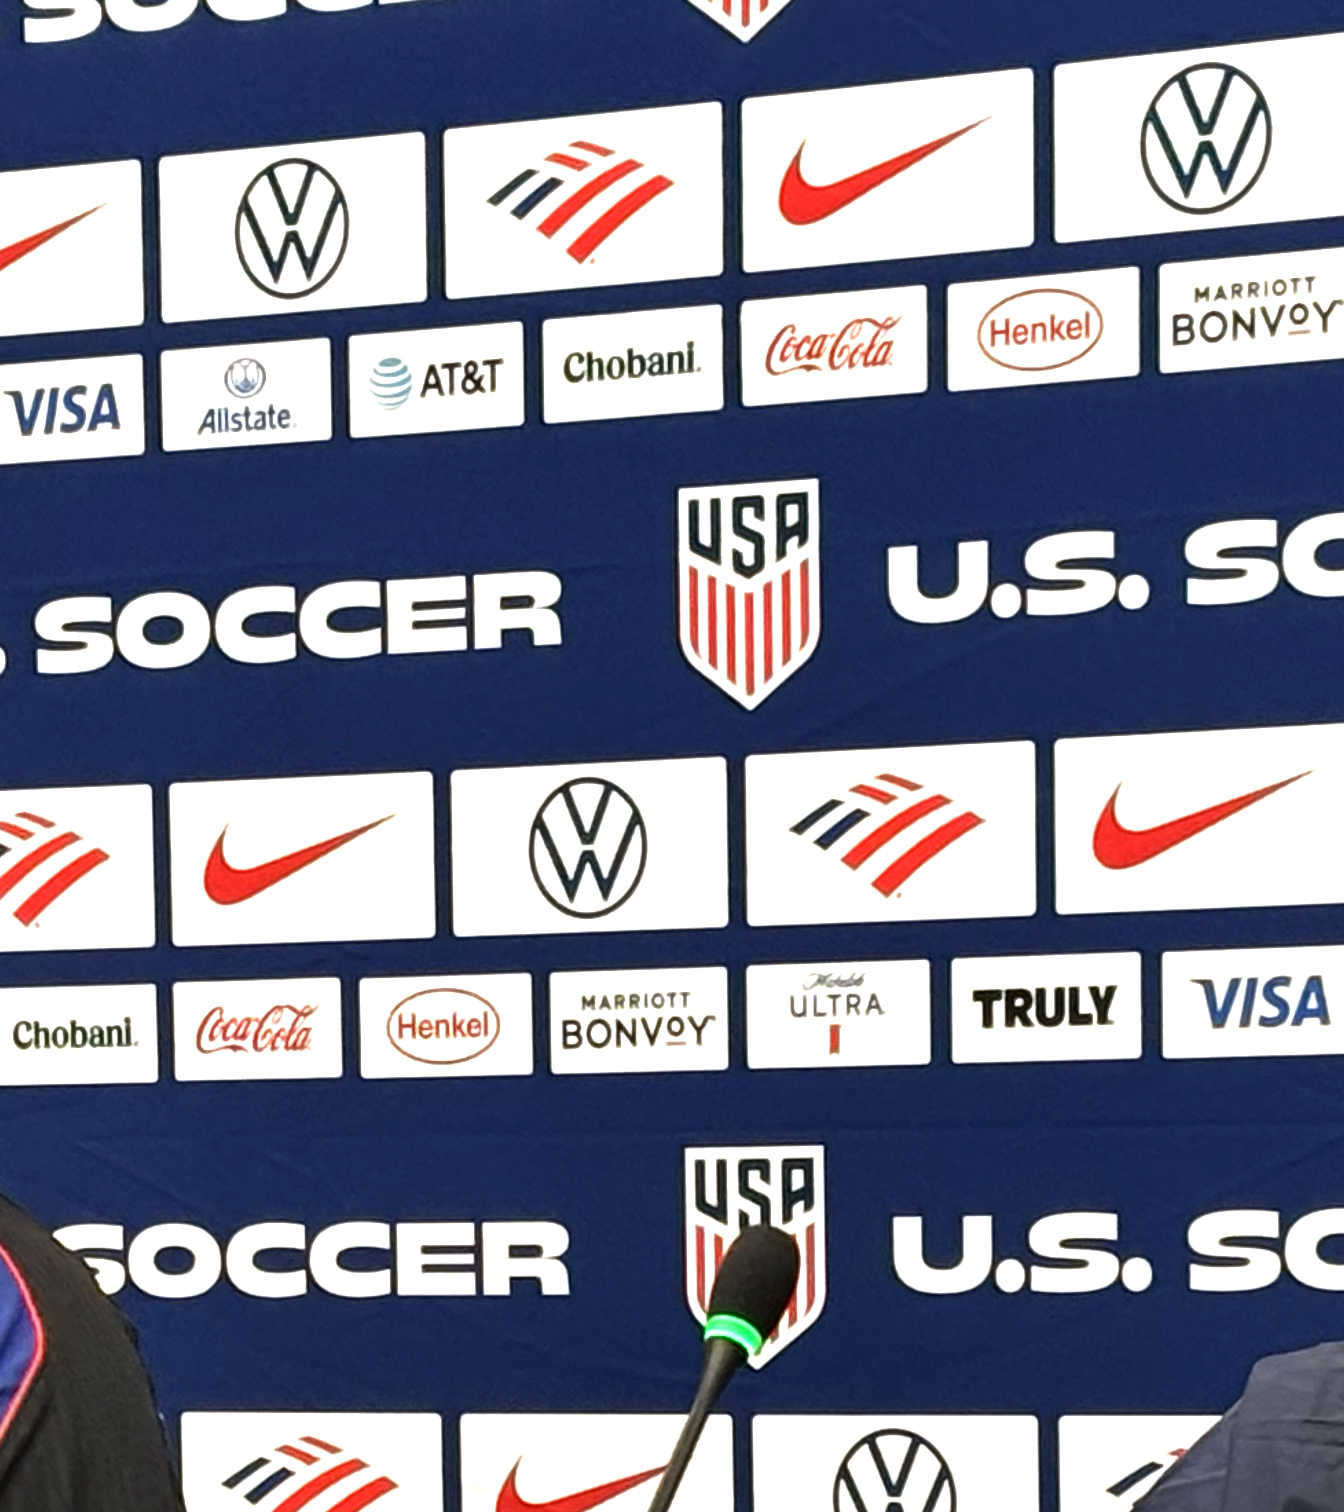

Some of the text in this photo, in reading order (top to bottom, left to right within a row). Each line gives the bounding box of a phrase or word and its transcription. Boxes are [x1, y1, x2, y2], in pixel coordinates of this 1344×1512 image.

[1195, 276, 1315, 303] MARRIOTT
[990, 311, 1090, 347] Henkel
[420, 358, 504, 398] AT&T
[4, 383, 120, 436] VISA
[689, 492, 808, 578] USA
[888, 531, 1149, 623] U.S.
[35, 572, 561, 673] SOCCER
[398, 1011, 488, 1039] Henkel
[582, 992, 690, 1010] MARRIOTT
[790, 993, 884, 1018] ULTRA
[972, 985, 1117, 1029] TRULY
[1190, 975, 1330, 1029] VISA
[694, 1157, 815, 1230] USA
[893, 1212, 1152, 1293] U.S.
